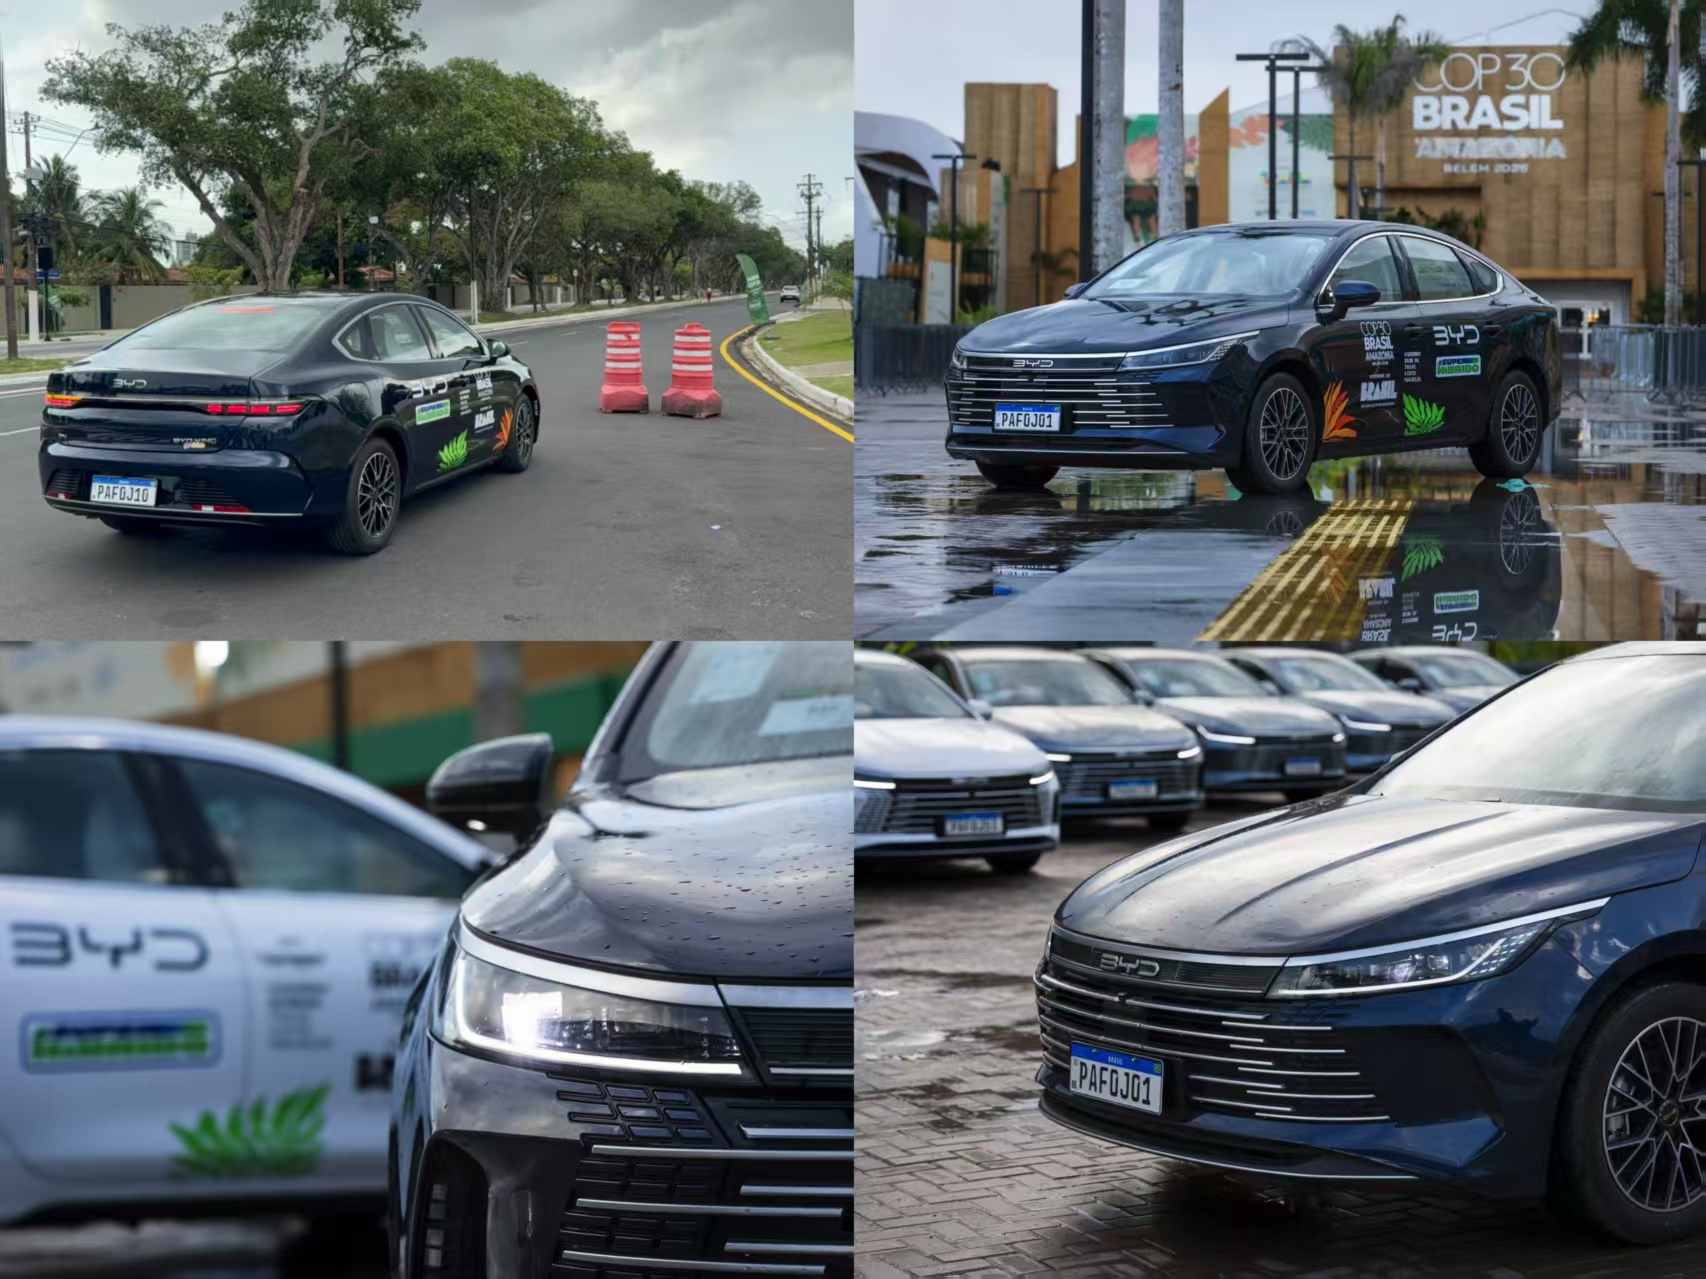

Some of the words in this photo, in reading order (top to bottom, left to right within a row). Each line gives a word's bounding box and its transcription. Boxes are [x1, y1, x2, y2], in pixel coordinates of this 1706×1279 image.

[1412, 94, 1565, 130] BRASIL
[1360, 320, 1392, 336] COP30
[1433, 324, 1480, 346] BYD
[1363, 335, 1394, 351] BRASIL
[1013, 359, 1054, 368] BYD
[112, 378, 148, 389] BYD
[9, 922, 209, 972] BYD
[1100, 953, 1160, 977] BYD
